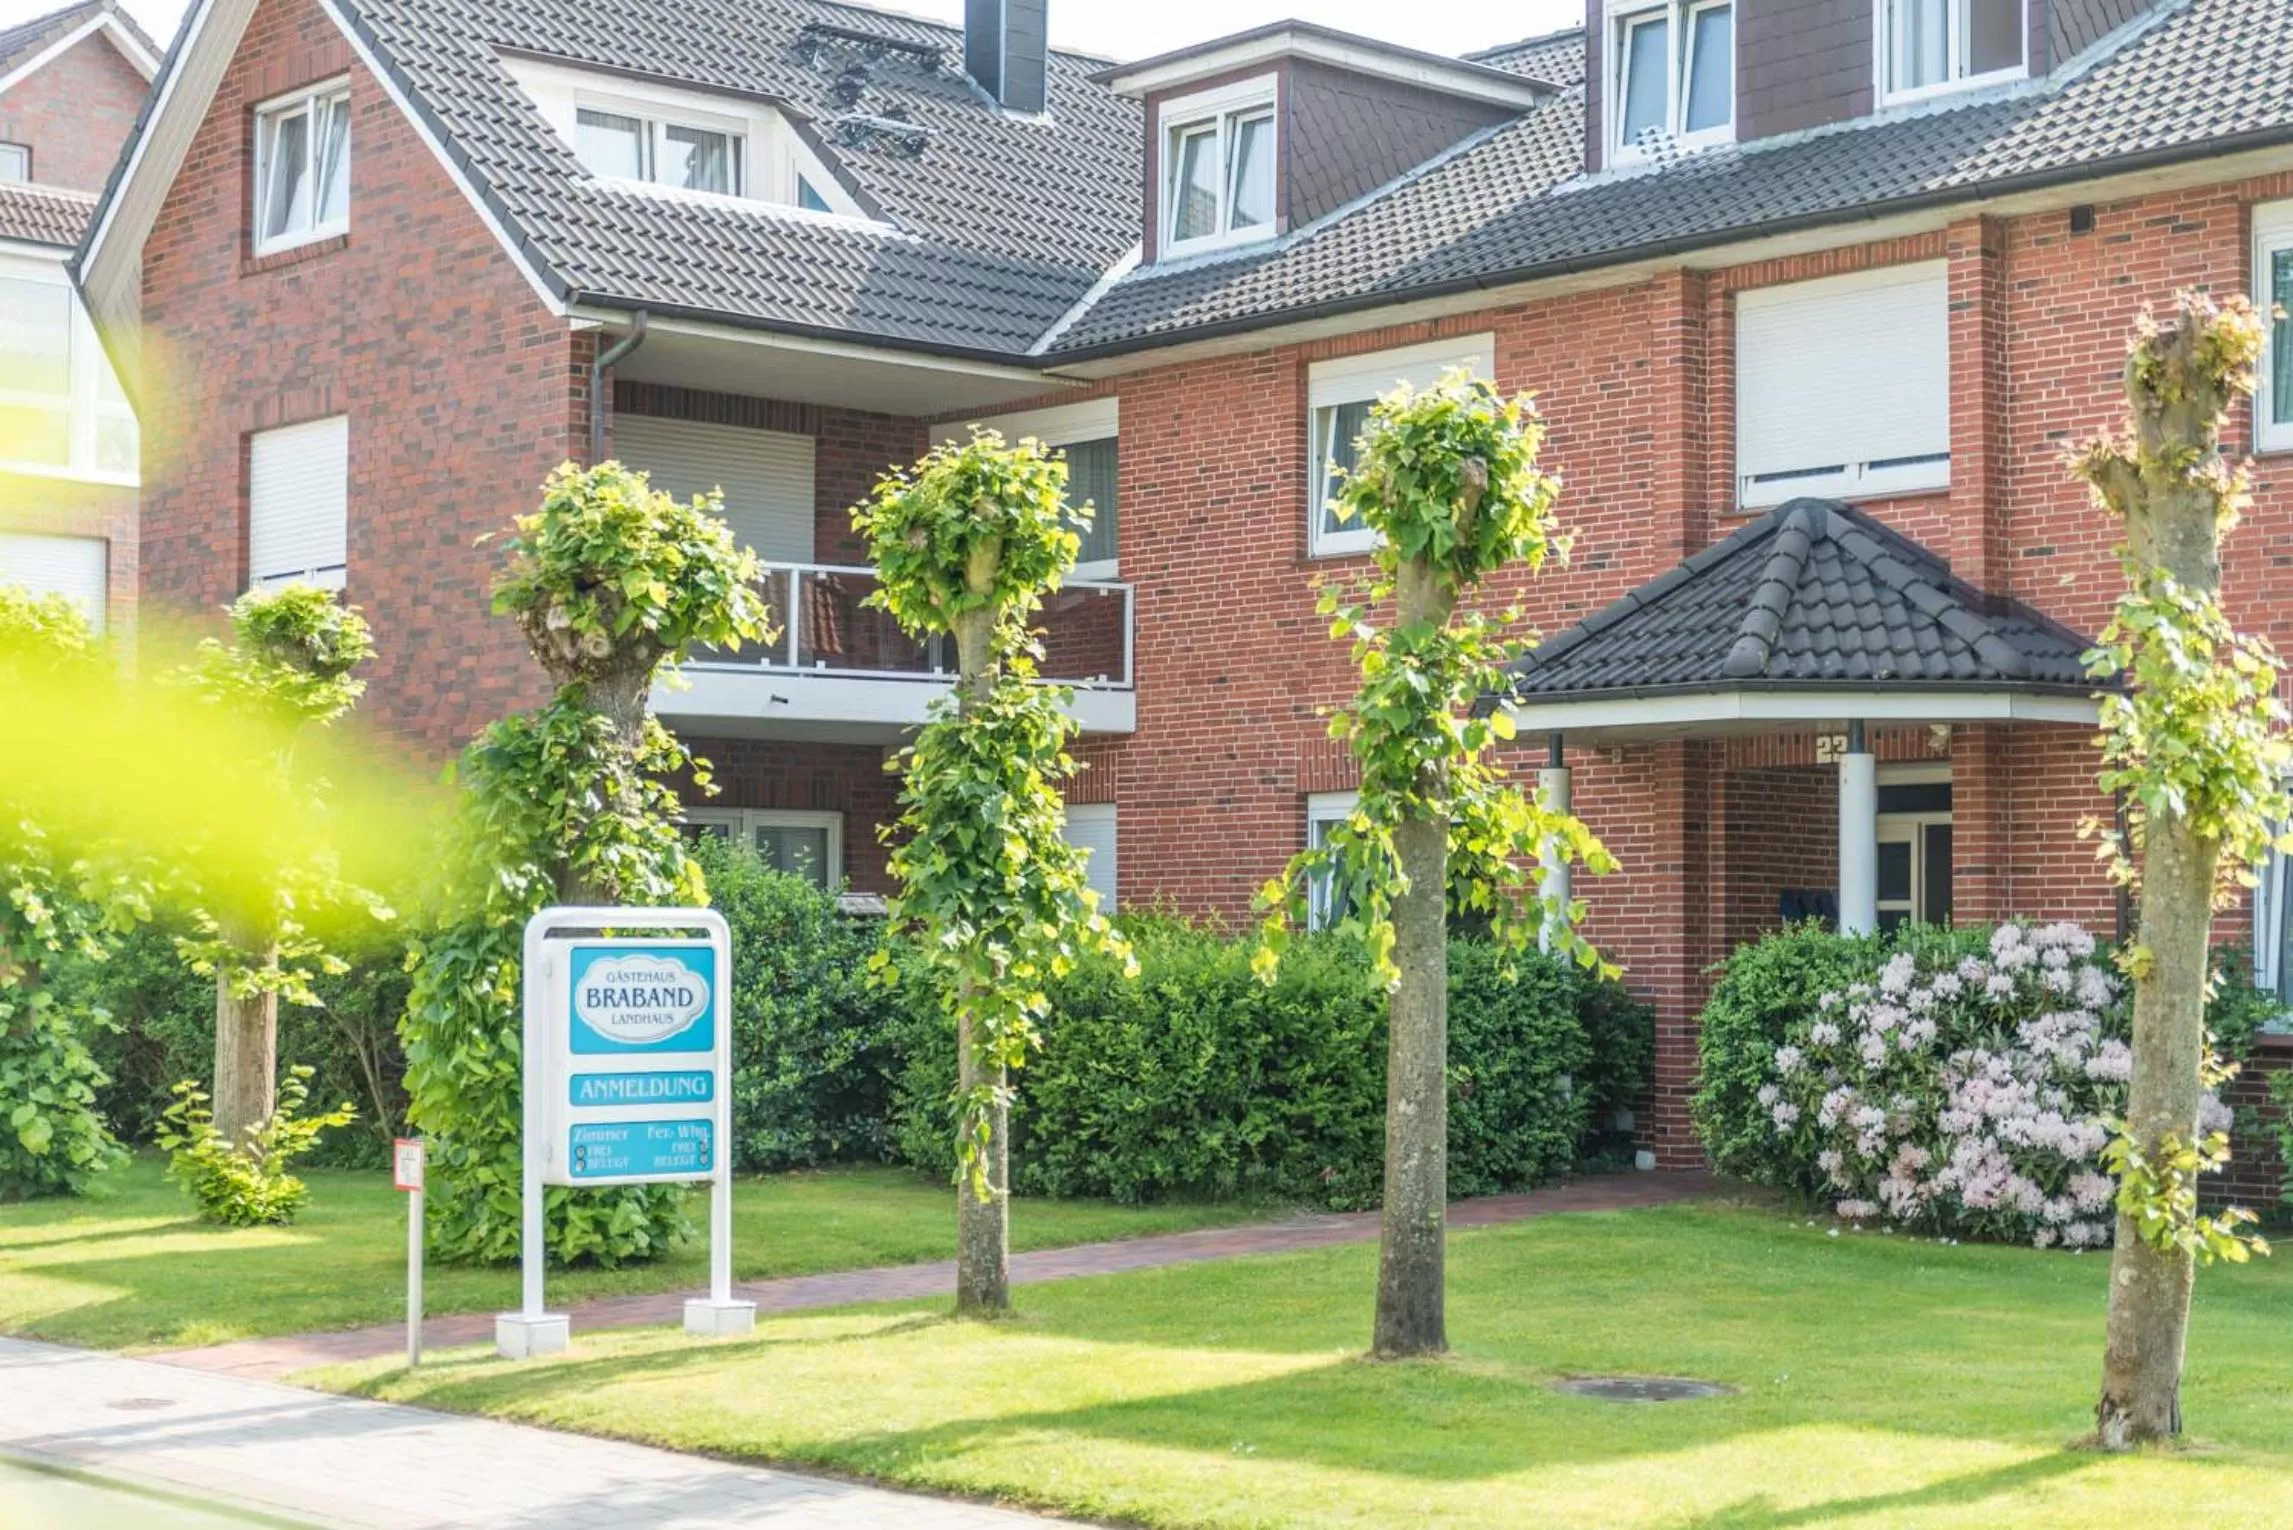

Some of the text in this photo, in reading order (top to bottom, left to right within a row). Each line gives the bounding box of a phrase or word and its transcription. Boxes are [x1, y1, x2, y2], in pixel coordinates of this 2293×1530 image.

[586, 987, 693, 1008] BRABAND
[611, 1013, 674, 1025] LANDHAUS
[580, 1076, 707, 1099] ANMELDUNG
[573, 1127, 629, 1142] Zimmer
